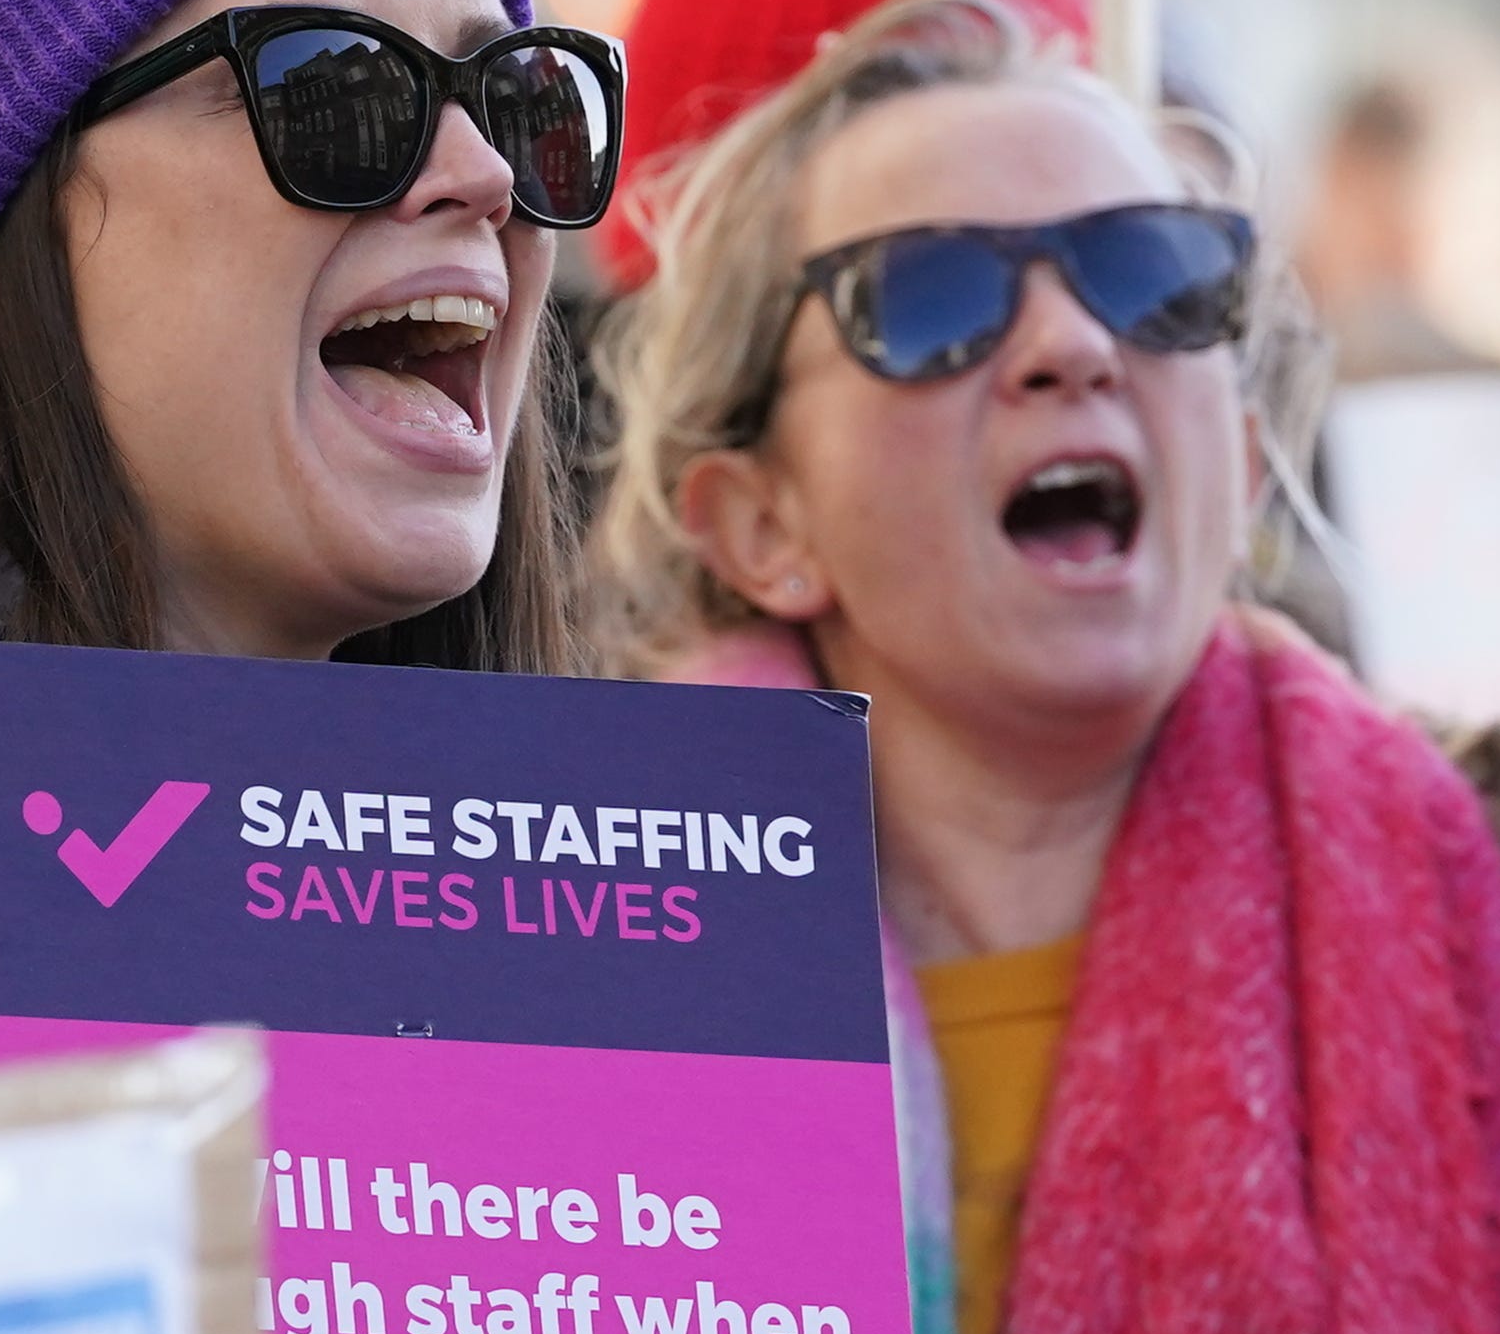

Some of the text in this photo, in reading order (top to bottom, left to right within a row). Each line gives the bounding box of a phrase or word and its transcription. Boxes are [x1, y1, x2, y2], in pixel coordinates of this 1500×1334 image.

[240, 785, 815, 877] SAFE STAFFING
[245, 861, 701, 944] SAVES LIVES
[256, 1150, 721, 1250] ill there be
